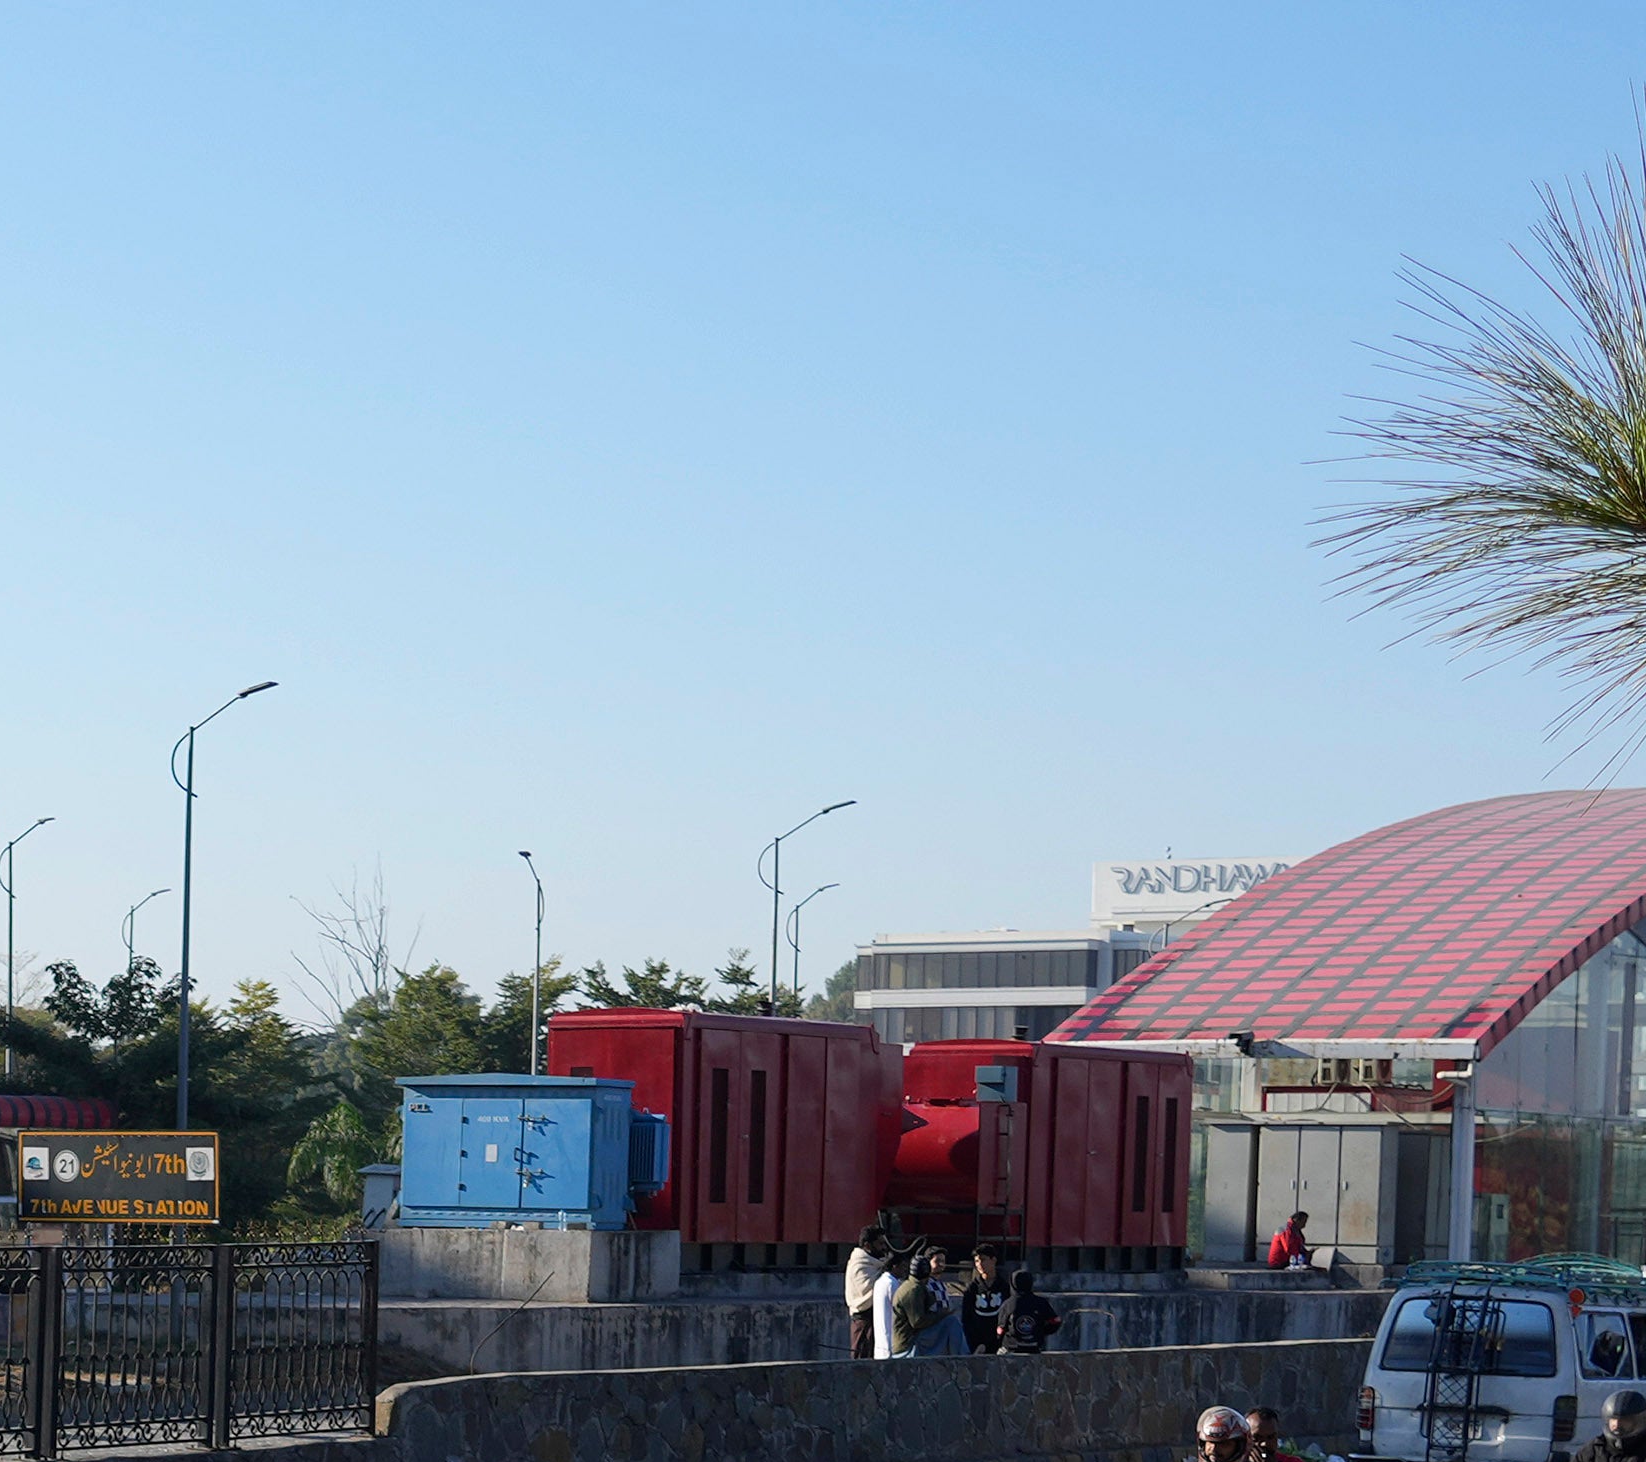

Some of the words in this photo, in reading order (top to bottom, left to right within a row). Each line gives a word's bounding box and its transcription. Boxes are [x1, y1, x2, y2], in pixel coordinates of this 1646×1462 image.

[59, 1158, 76, 1174] 21
[153, 1153, 185, 1175] 7th
[30, 1198, 57, 1214] 7th
[60, 1198, 129, 1215] AVENUE
[133, 1198, 209, 1216] STATION
